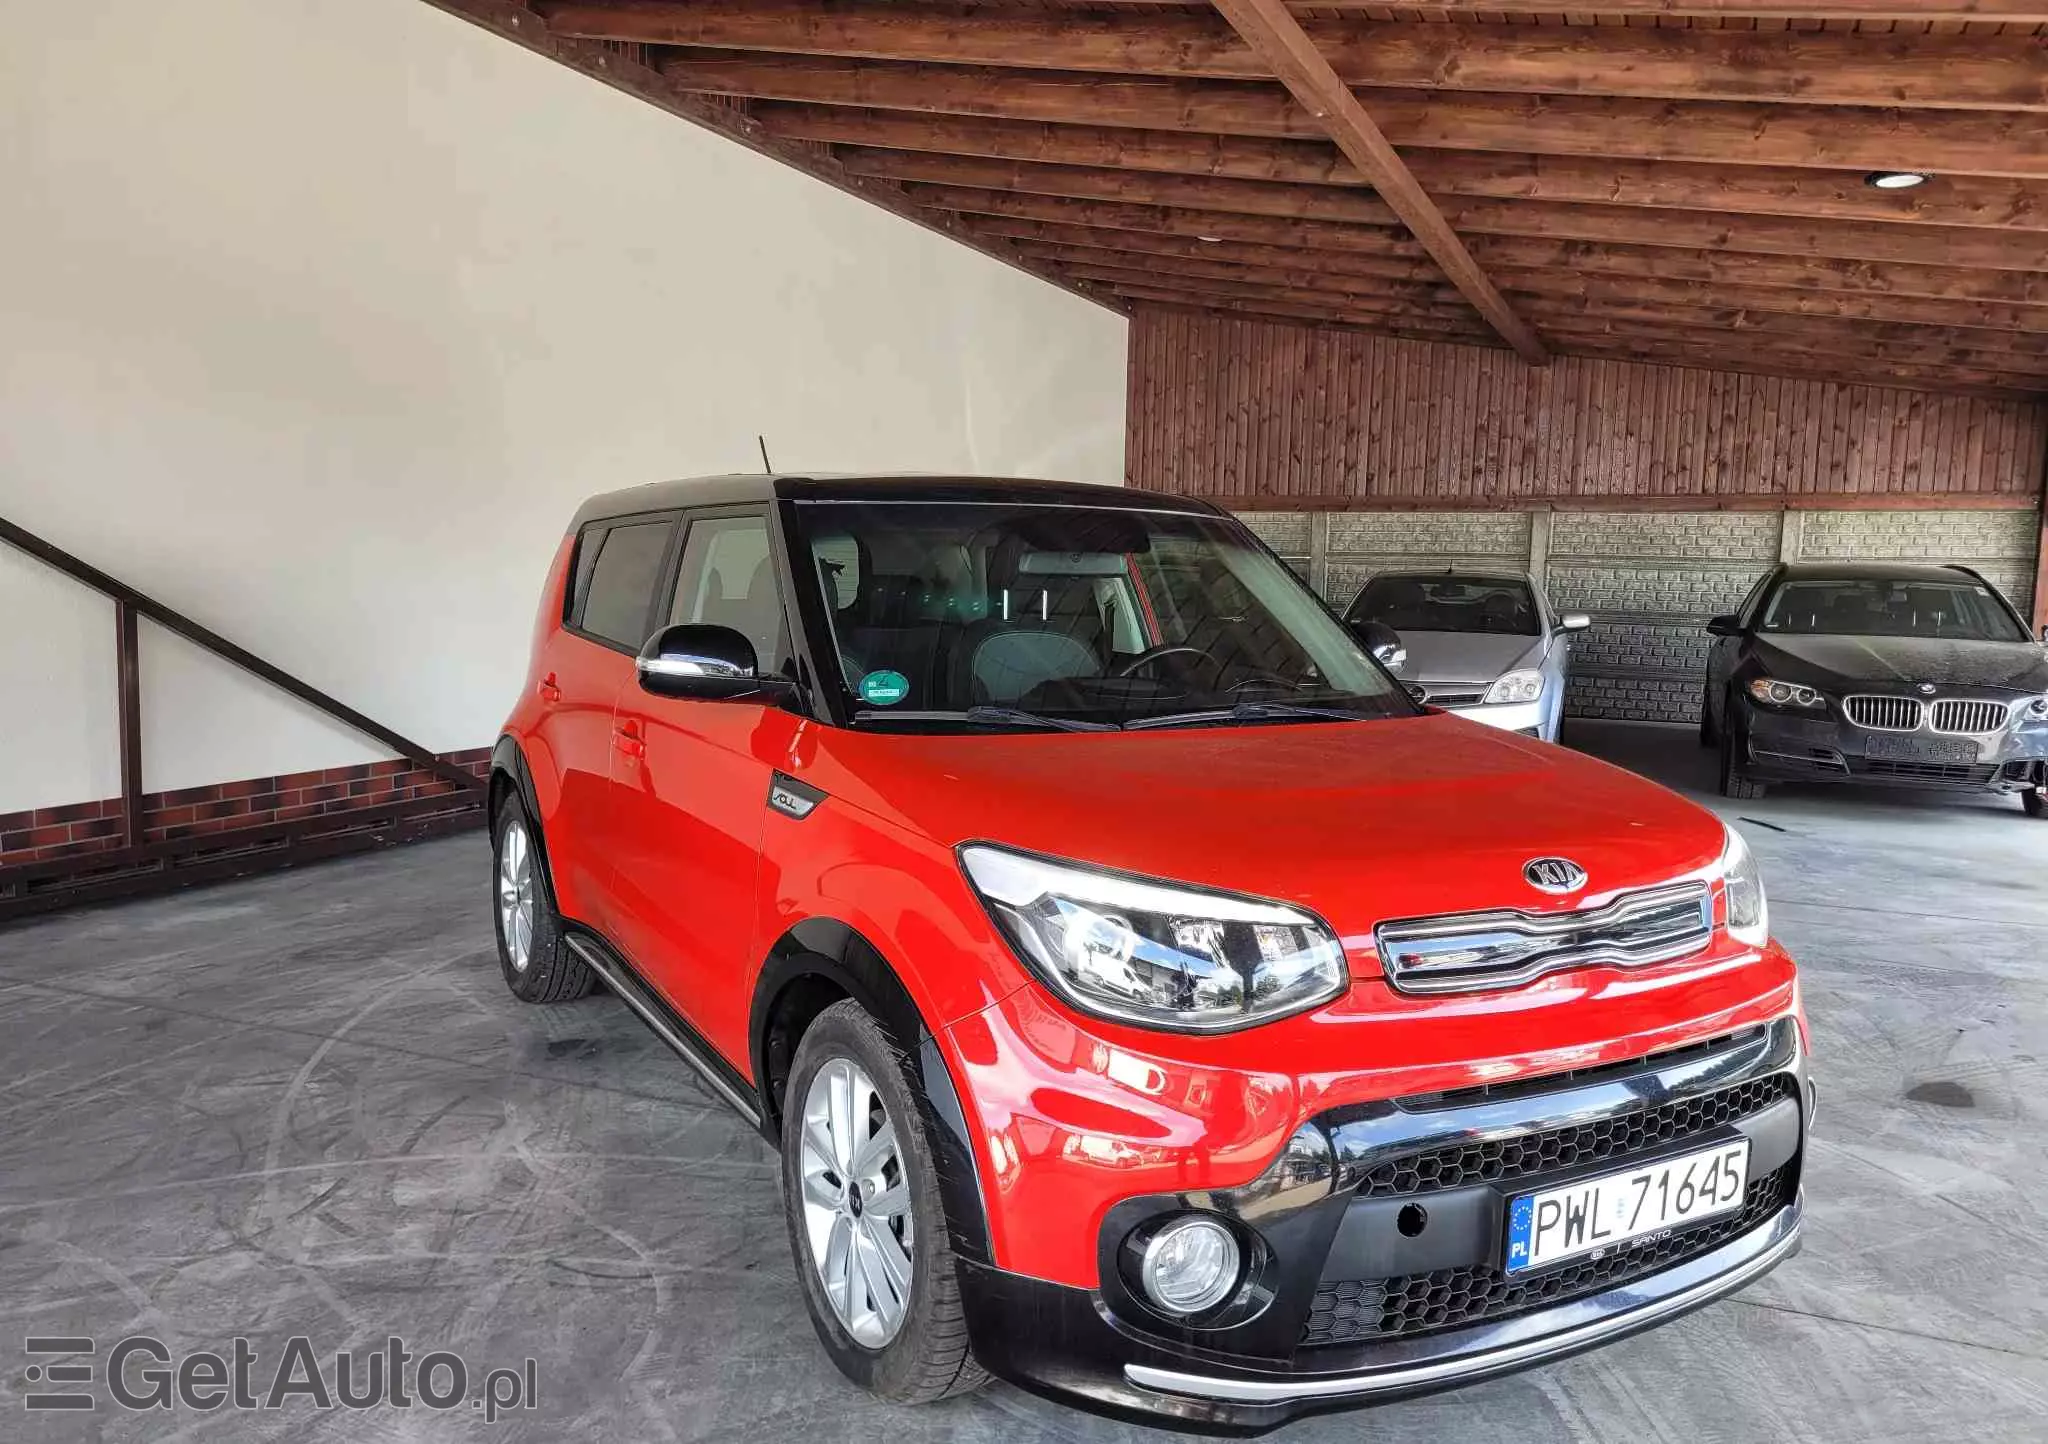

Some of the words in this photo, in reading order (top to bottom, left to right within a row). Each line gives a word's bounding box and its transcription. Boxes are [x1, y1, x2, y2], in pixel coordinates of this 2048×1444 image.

[1531, 861, 1579, 885] KIA
[1534, 1187, 1611, 1257] PWL
[1628, 1150, 1742, 1231] 71645
[1511, 1241, 1529, 1258] PL
